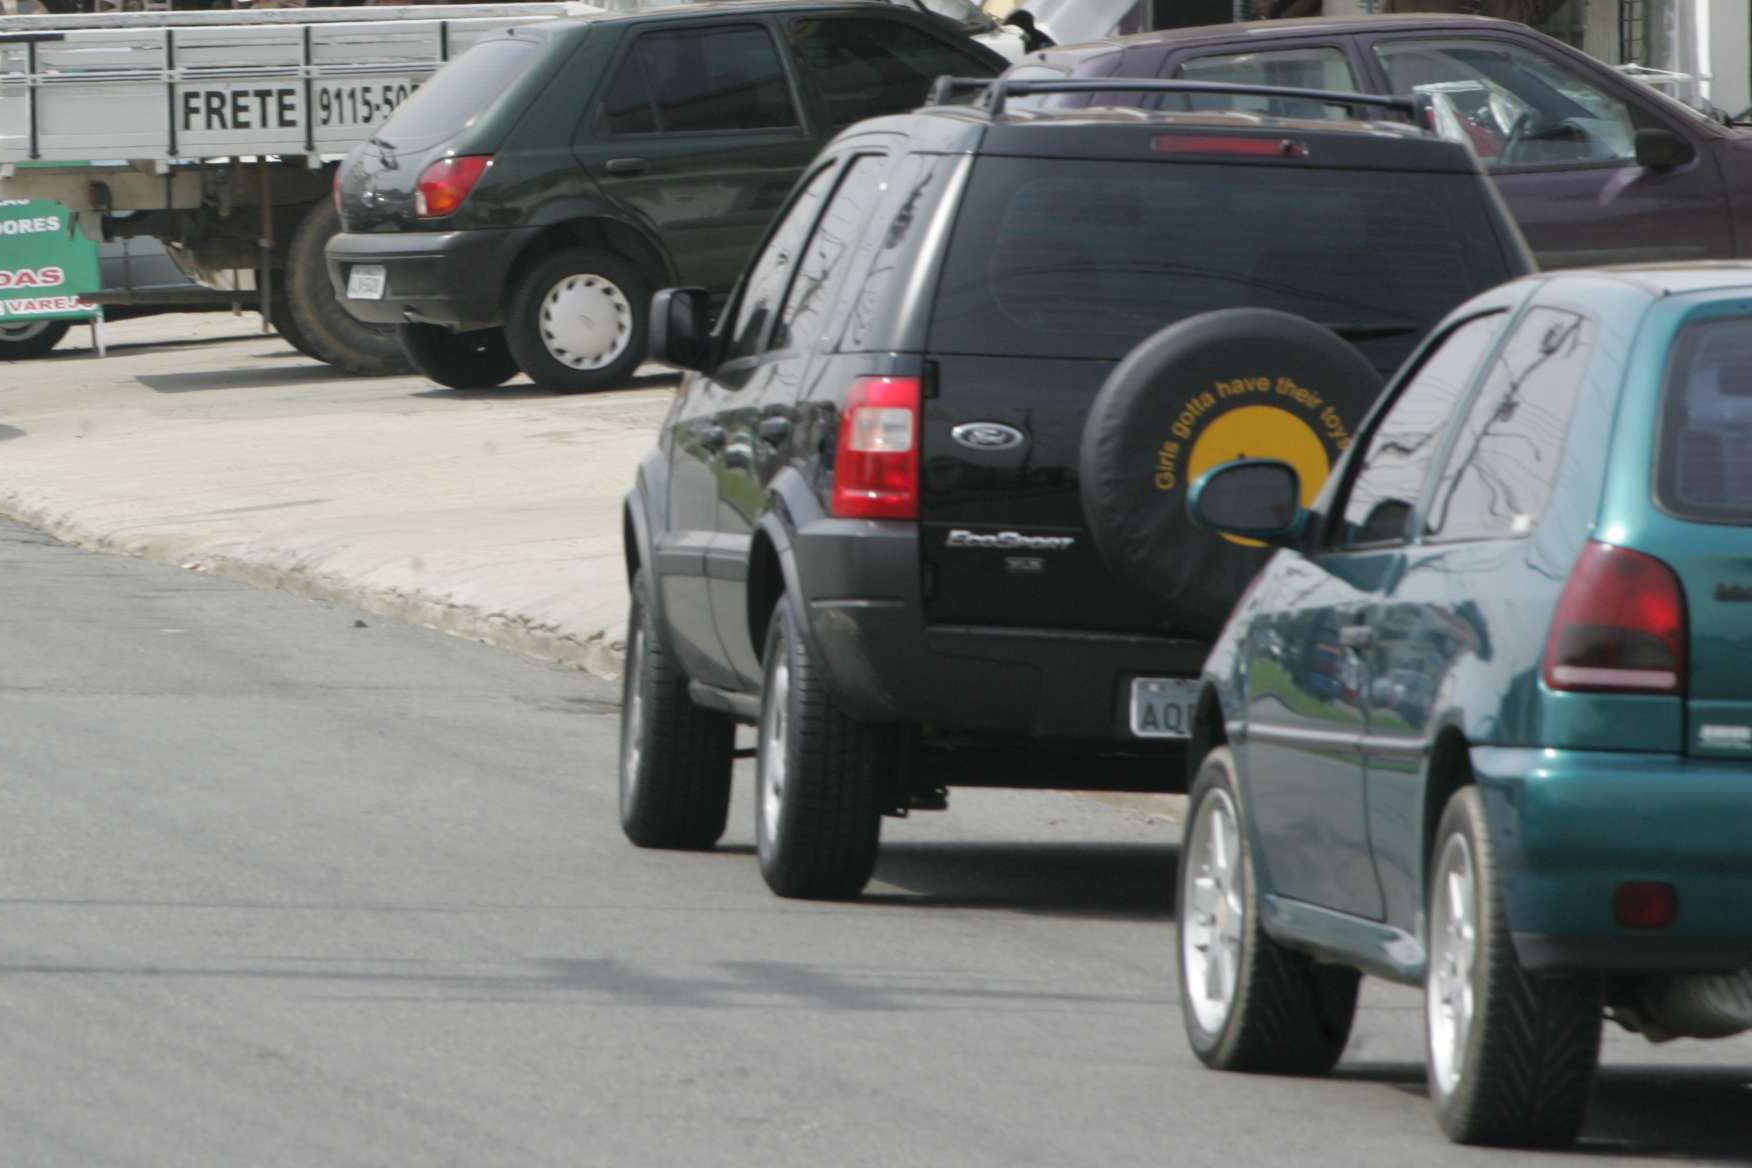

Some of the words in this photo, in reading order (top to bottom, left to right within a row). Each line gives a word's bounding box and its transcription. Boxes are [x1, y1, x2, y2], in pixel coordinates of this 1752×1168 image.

[182, 88, 297, 131] FRETE
[1153, 440, 1181, 491] Girls
[1171, 391, 1217, 440] gotta
[1214, 375, 1271, 399] have
[1275, 375, 1324, 410] their
